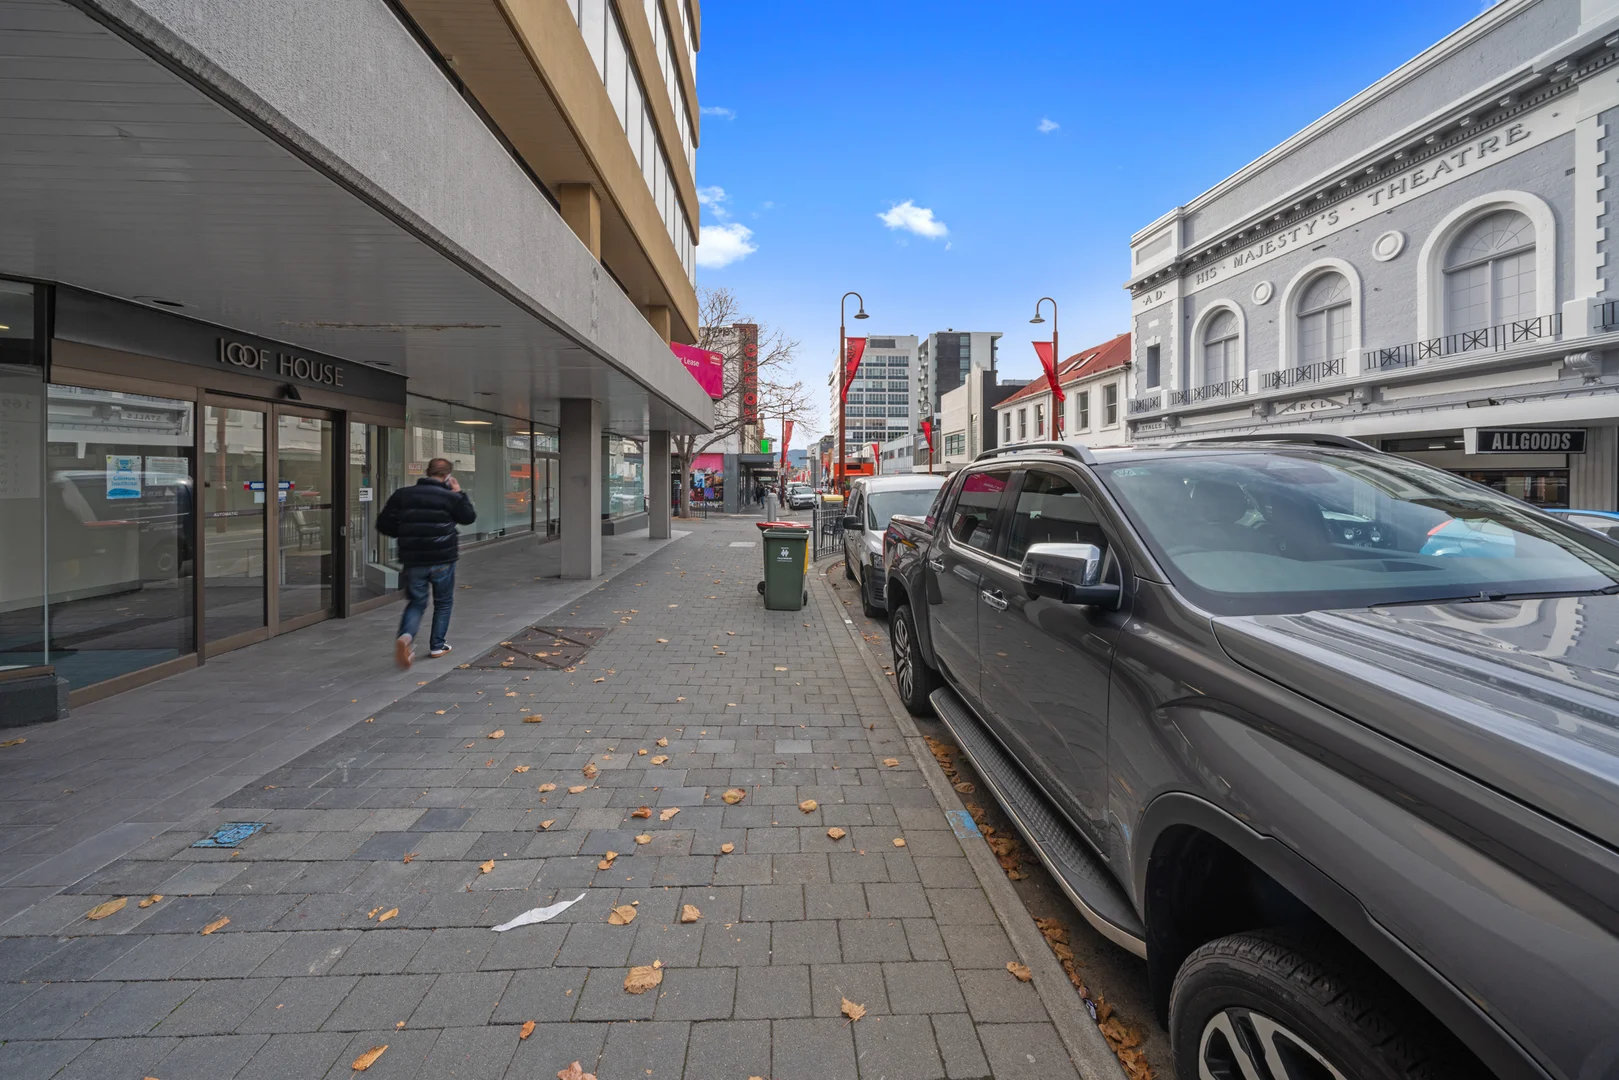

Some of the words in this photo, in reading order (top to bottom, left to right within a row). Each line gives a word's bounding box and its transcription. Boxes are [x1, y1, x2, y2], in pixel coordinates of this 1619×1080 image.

[1195, 267, 1218, 286] HIS
[1233, 209, 1341, 269] MAJESTY'S
[1367, 122, 1532, 207] THEATRE
[219, 337, 271, 371] IOOF
[280, 353, 344, 388] HOUSE
[684, 356, 700, 368] Lease
[1141, 422, 1163, 431] STALLS
[1491, 432, 1571, 450] ALLGOODS
